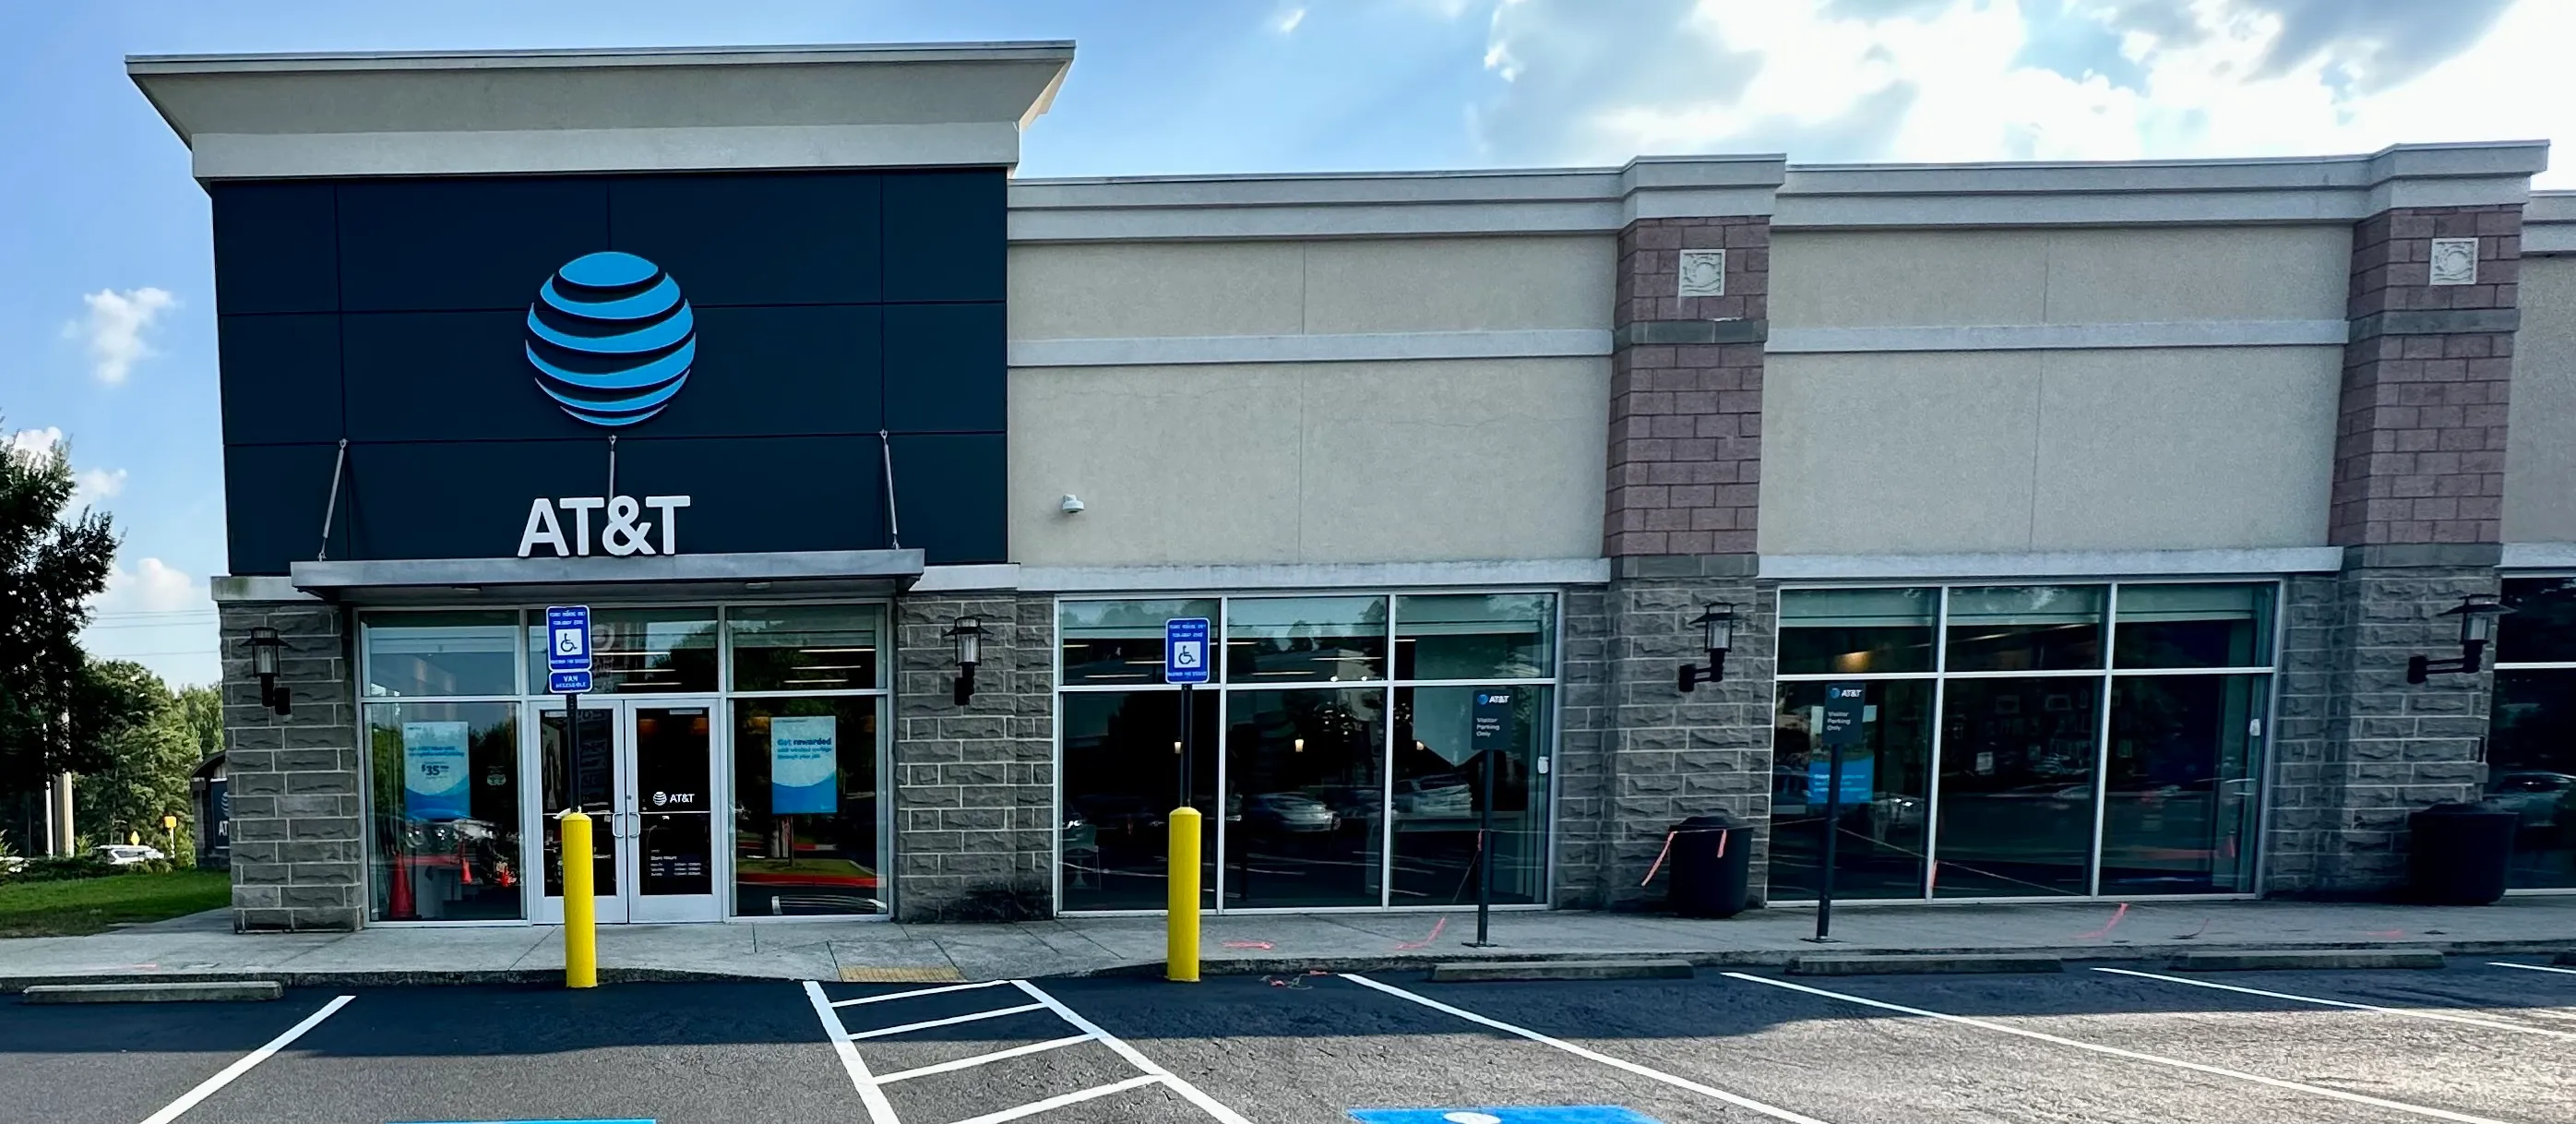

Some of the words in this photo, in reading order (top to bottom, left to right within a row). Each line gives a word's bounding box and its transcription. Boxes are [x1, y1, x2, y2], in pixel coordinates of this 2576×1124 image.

[518, 496, 690, 556] AT&T
[1841, 689, 1863, 698] AT&T
[1489, 695, 1510, 703] AT&T
[421, 764, 440, 775] $35
[669, 794, 695, 803] AT&T
[218, 820, 229, 836] AT
